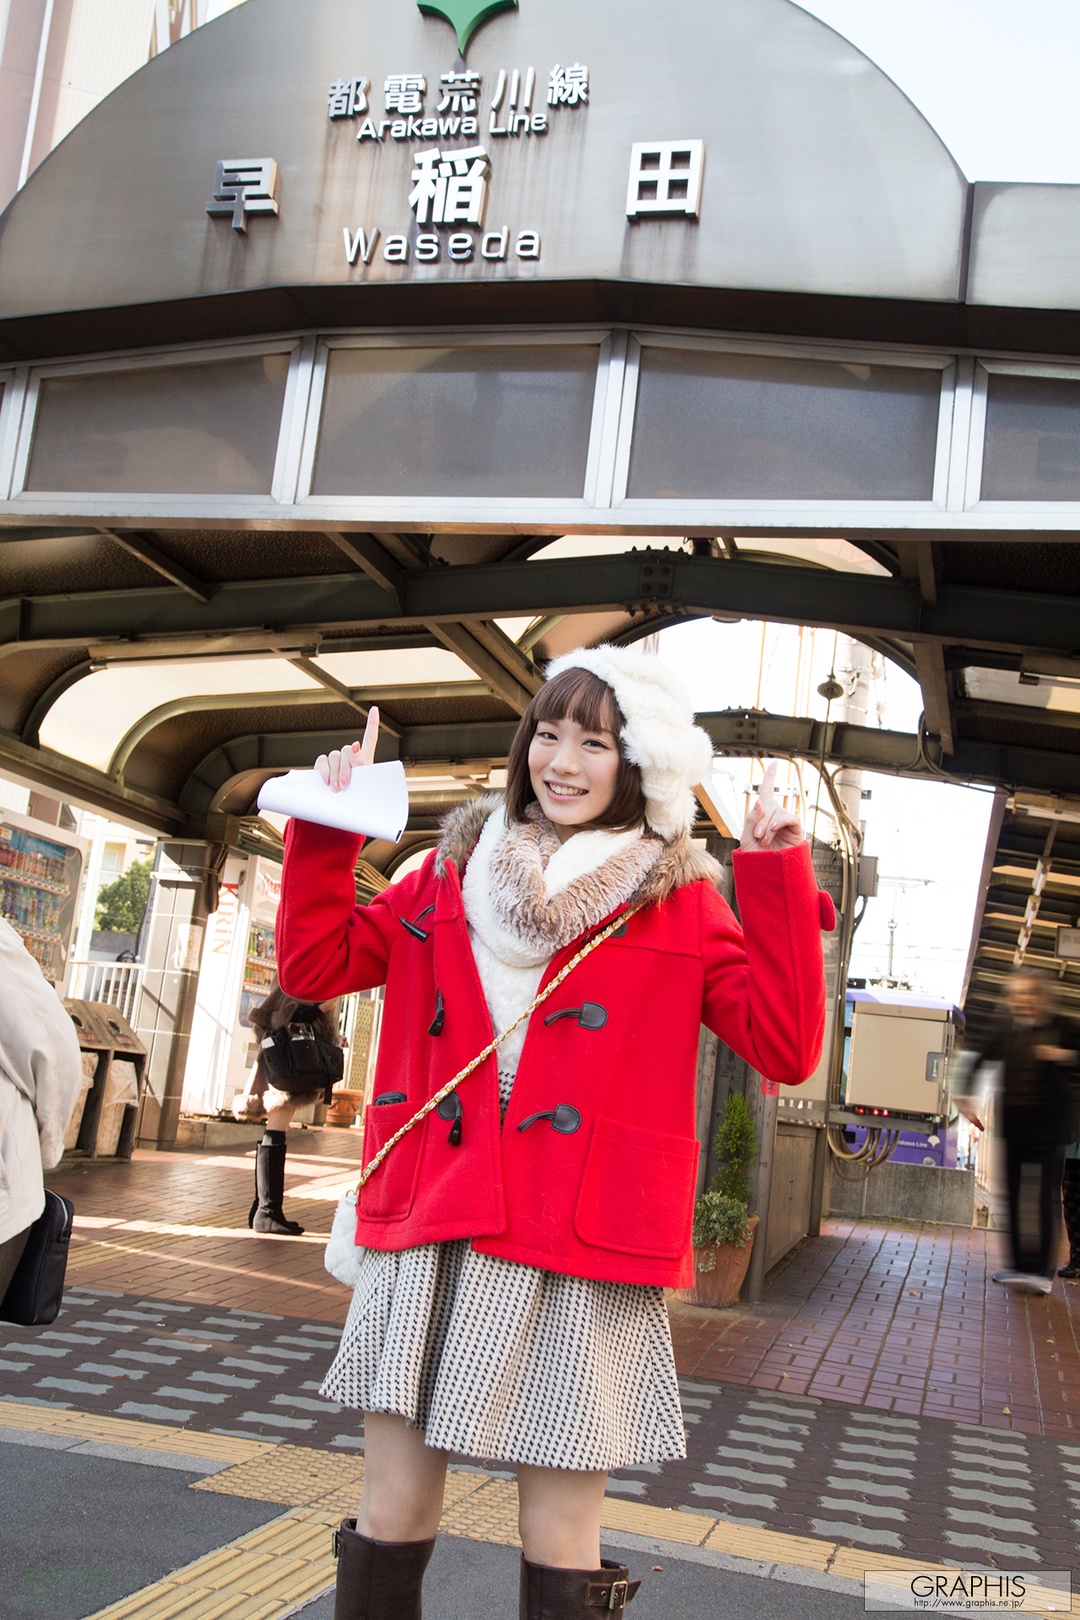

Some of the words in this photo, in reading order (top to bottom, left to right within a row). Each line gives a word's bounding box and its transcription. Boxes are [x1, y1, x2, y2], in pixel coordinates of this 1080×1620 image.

[327, 63, 590, 118] 都電荒川線
[356, 115, 478, 141] Arakawa
[488, 111, 548, 136] Line
[343, 225, 542, 265] Waseda
